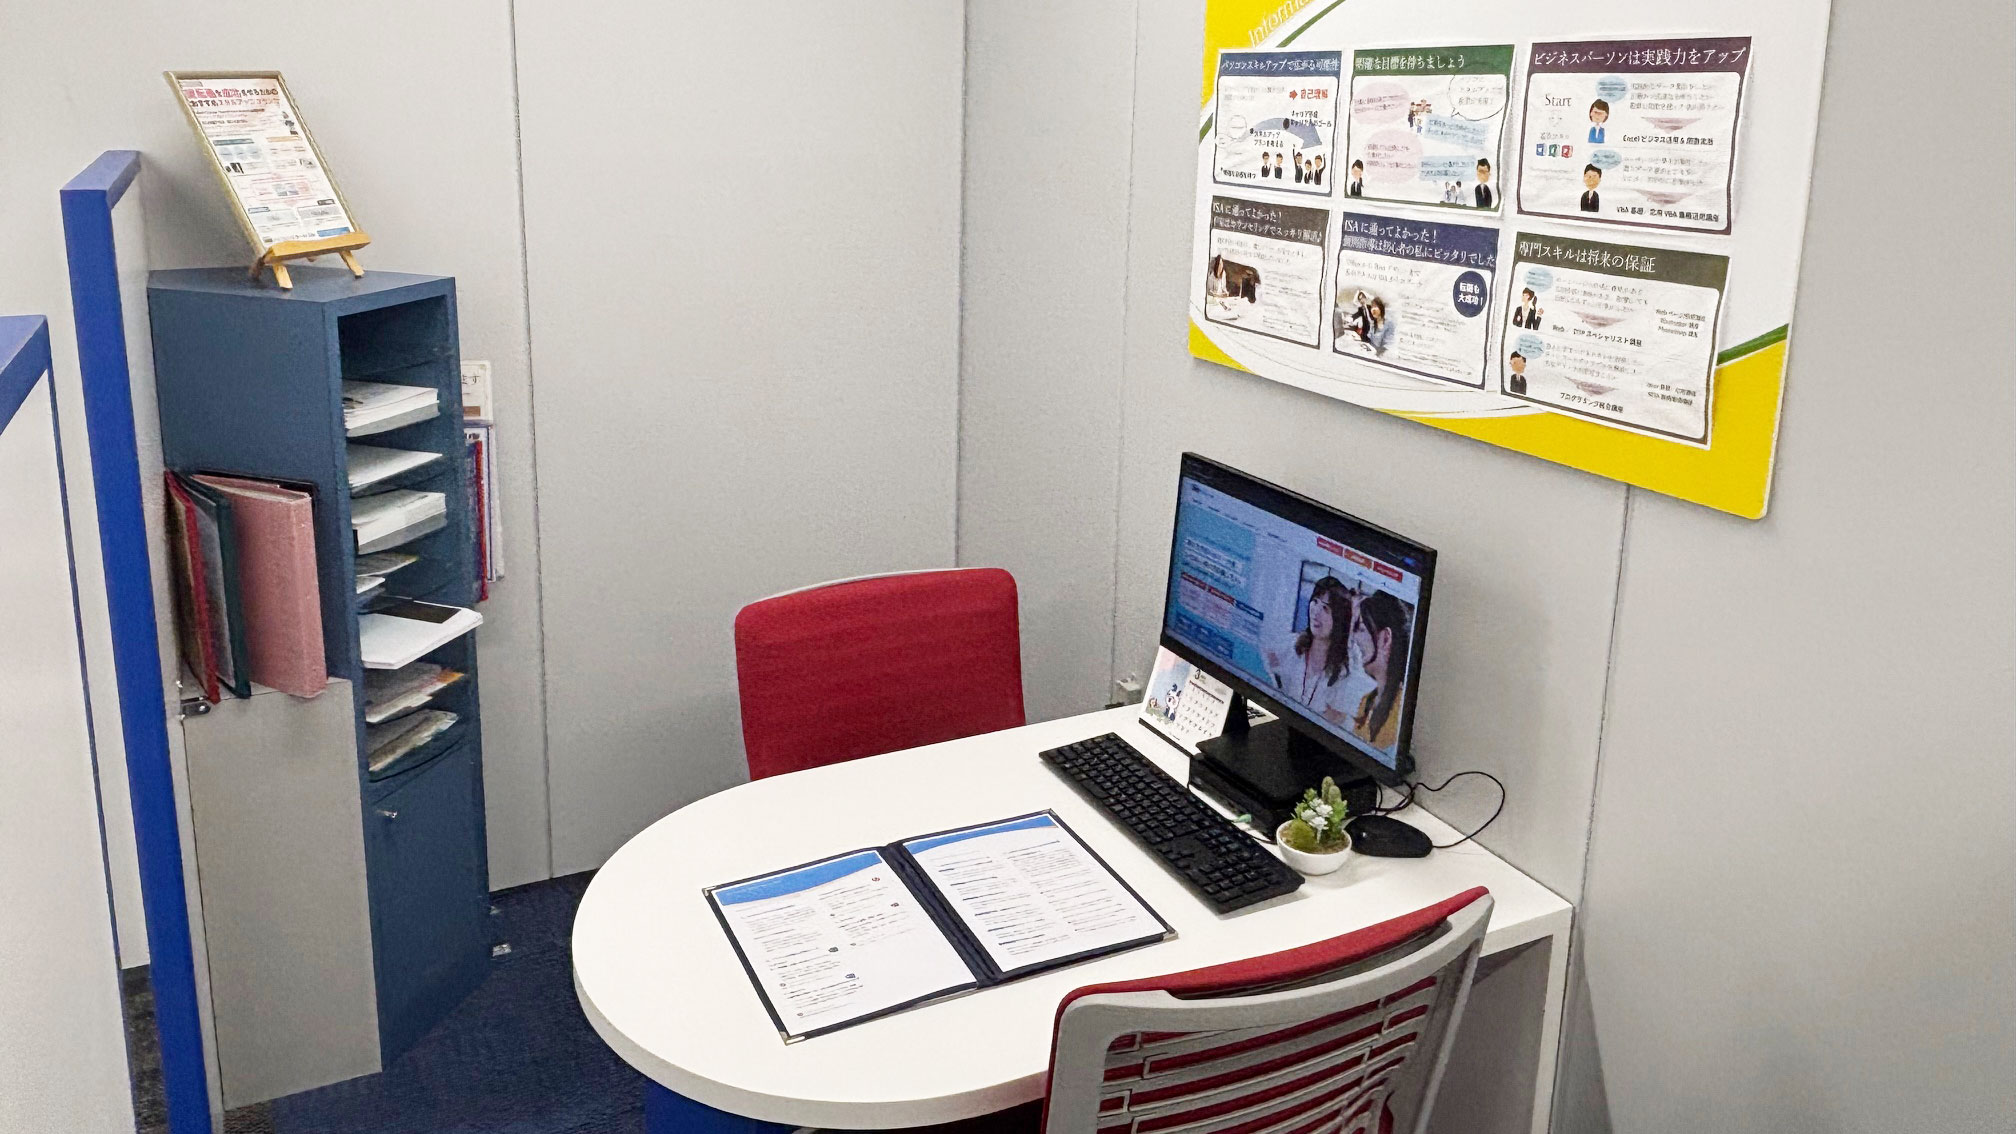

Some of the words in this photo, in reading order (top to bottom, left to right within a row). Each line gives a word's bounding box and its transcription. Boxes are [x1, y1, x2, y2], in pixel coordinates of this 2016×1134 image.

[1534, 47, 1747, 66] ビジネスパーソンは実践力をアップ
[1545, 94, 1572, 108] Start
[1519, 241, 1656, 273] 専門スキルは将来の保証
